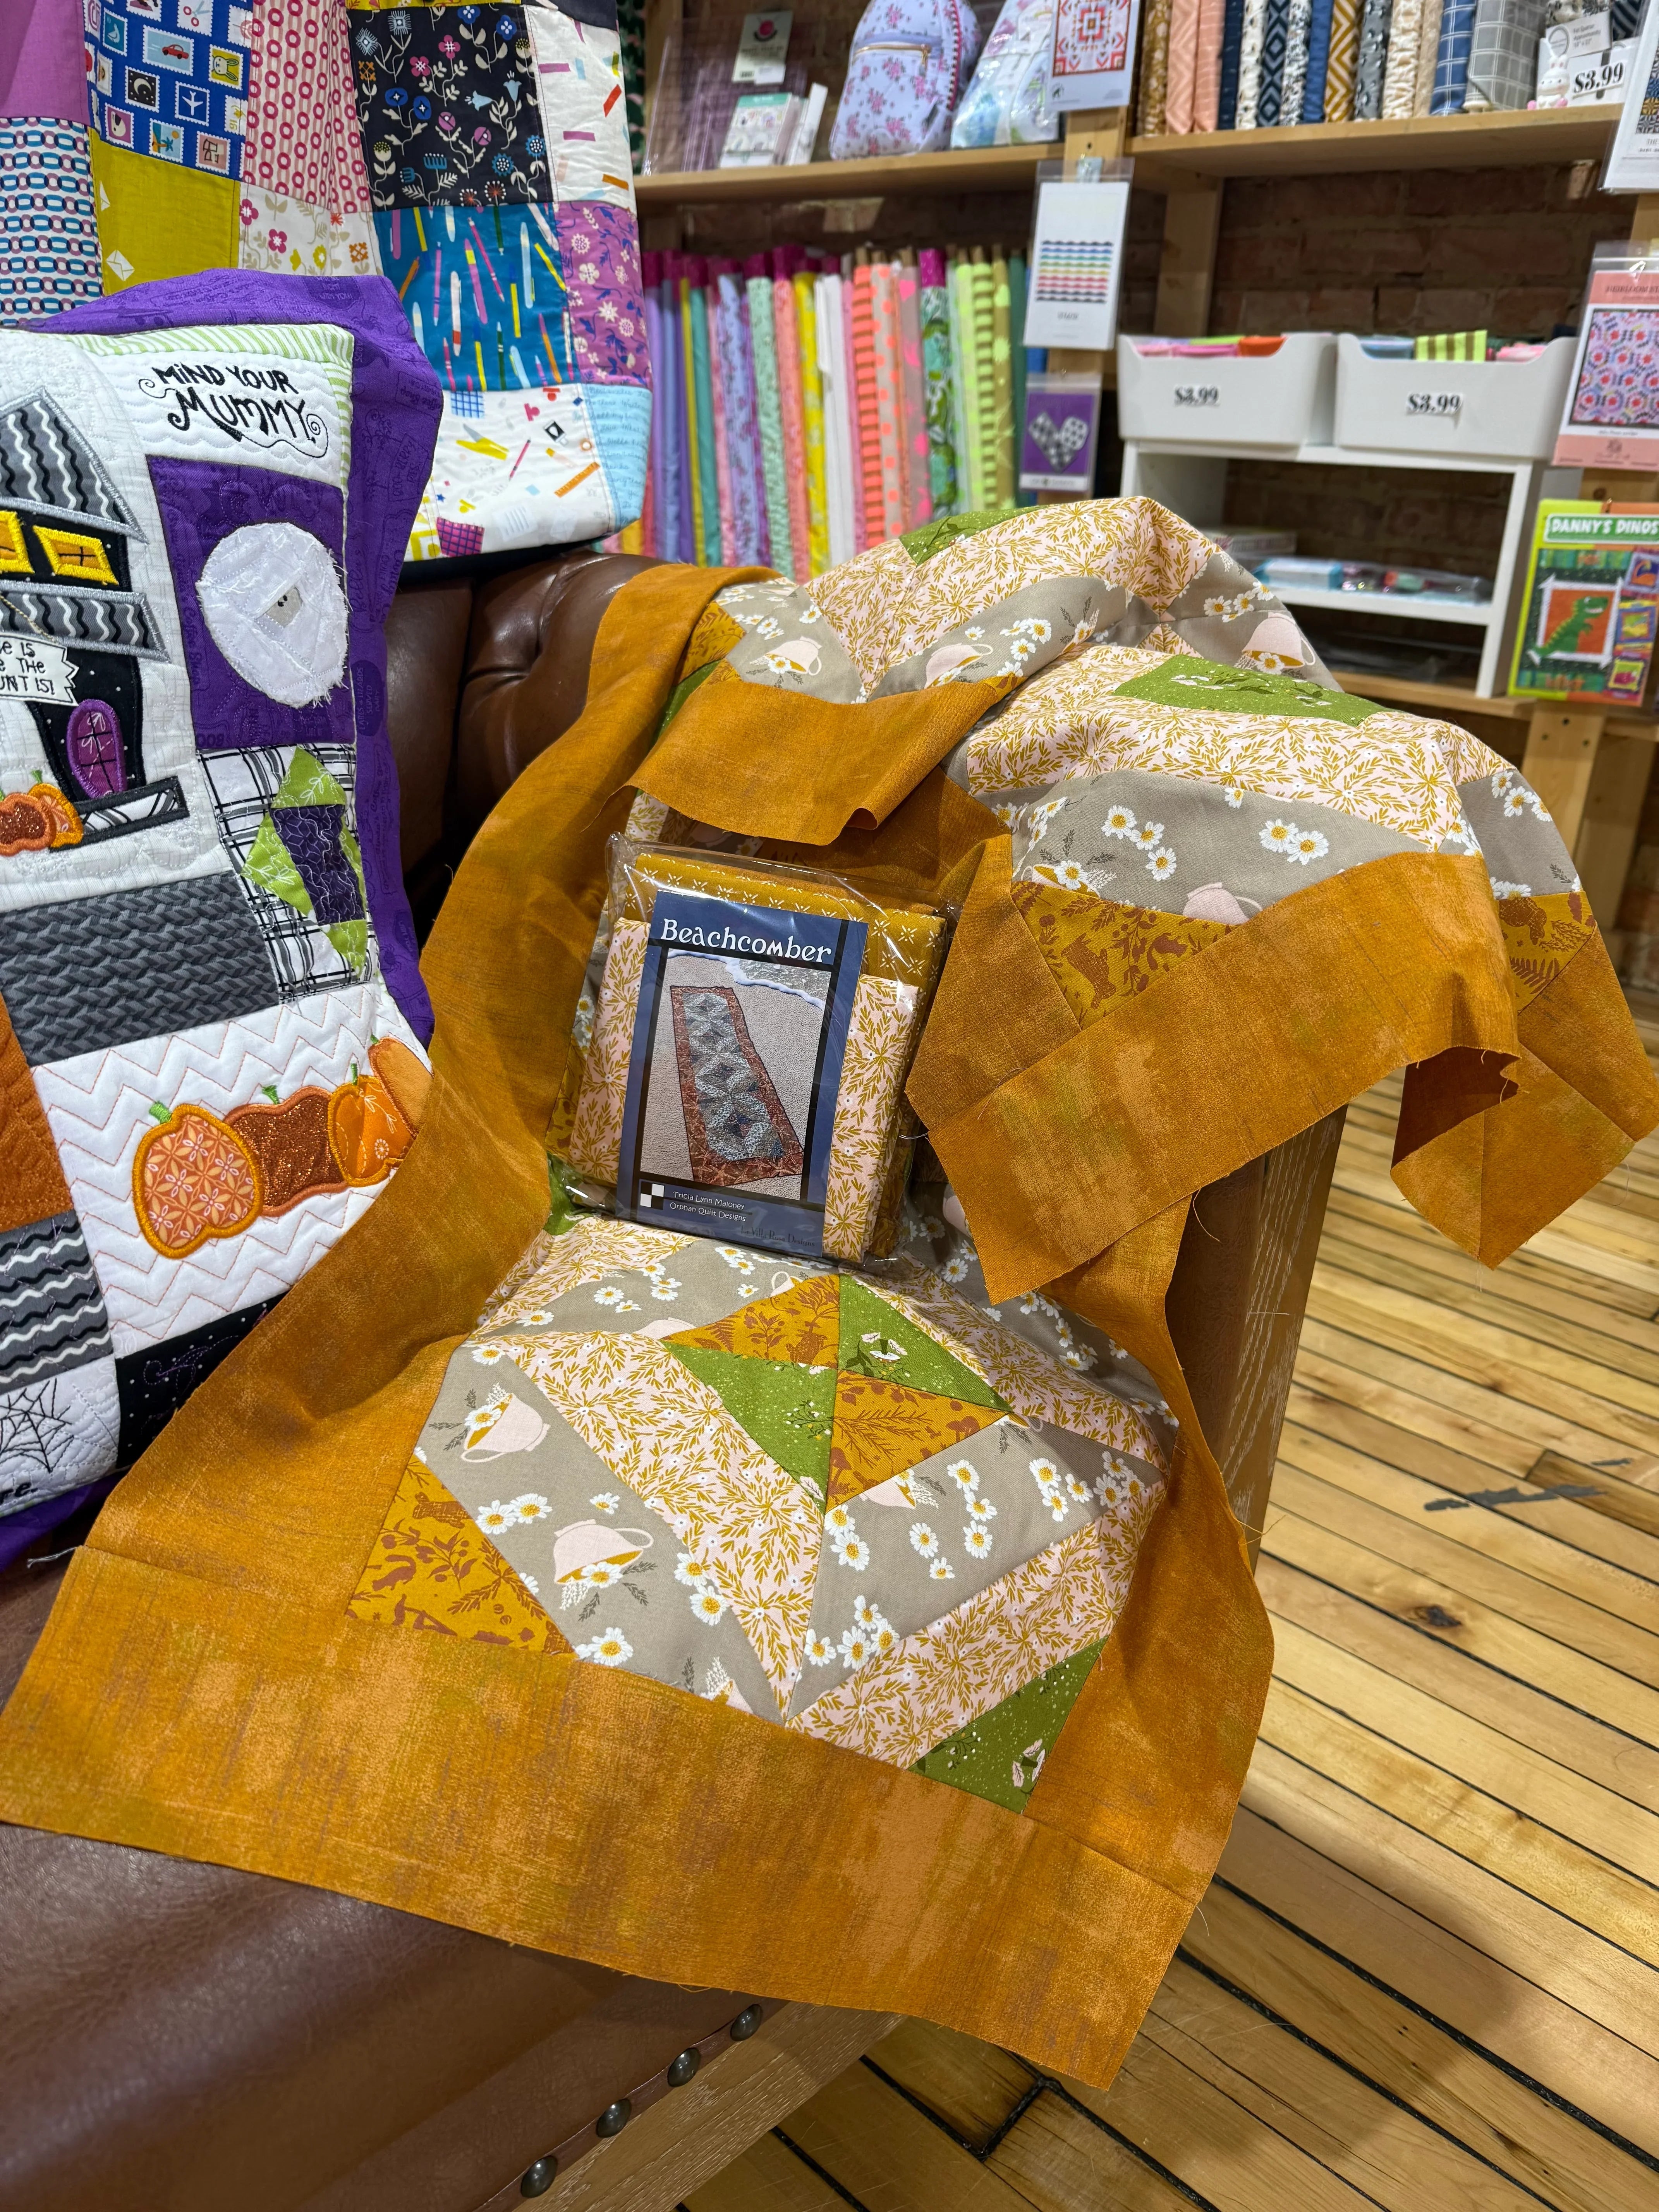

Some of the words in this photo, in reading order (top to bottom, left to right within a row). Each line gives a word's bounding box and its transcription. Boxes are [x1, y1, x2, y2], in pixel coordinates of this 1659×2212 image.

[1574, 62, 1624, 93] $3.99
[225, 366, 299, 395] YOUR
[1175, 386, 1219, 405] $3.99
[1408, 393, 1461, 413] $3.99
[167, 386, 316, 444] MUMMY
[1552, 519, 1613, 534] DANNY'S
[21, 642, 36, 658] IS
[660, 918, 832, 963] Beachcomber
[673, 1191, 694, 1201] Tricia
[696, 1195, 713, 1205] Lynn
[714, 1198, 745, 1210] Maloney
[670, 1202, 696, 1213] Orphan
[698, 1207, 717, 1217] Quilt
[719, 1211, 747, 1222] Designs
[788, 1233, 815, 1247] Designs
